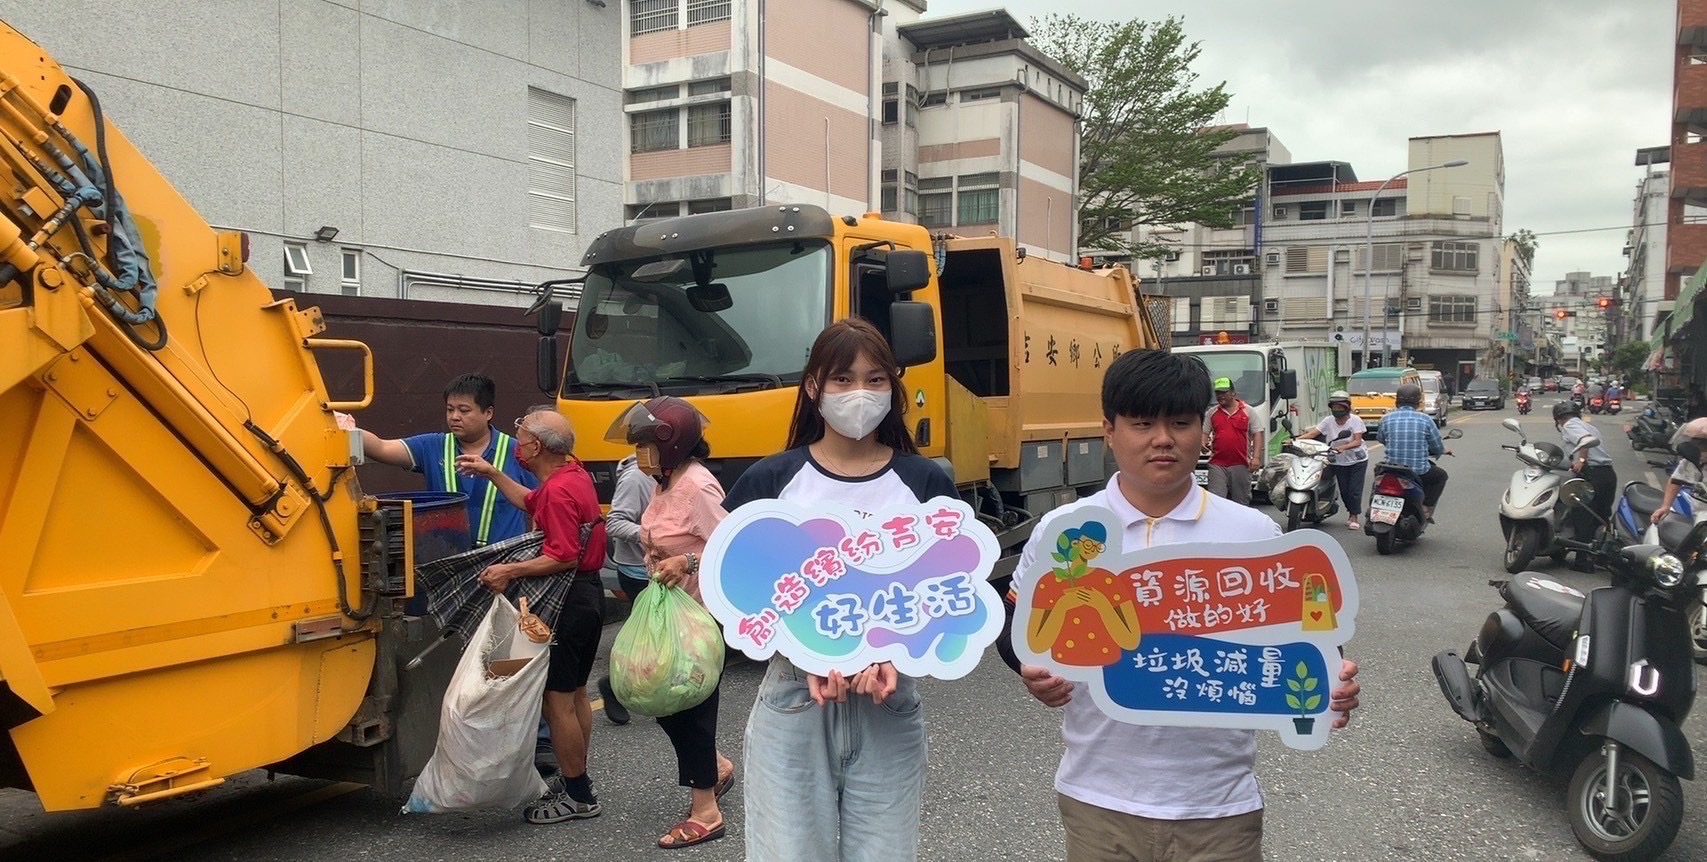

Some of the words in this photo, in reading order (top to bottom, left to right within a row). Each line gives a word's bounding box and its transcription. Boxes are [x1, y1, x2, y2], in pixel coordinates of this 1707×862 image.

[738, 508, 961, 647] 創造繽紛吉安
[1130, 562, 1300, 607] 資源回收
[815, 575, 971, 635] 好生活
[1164, 598, 1271, 631] 做的好
[1133, 647, 1285, 688] 垃圾減量
[1162, 676, 1257, 706] 沒煩惱
